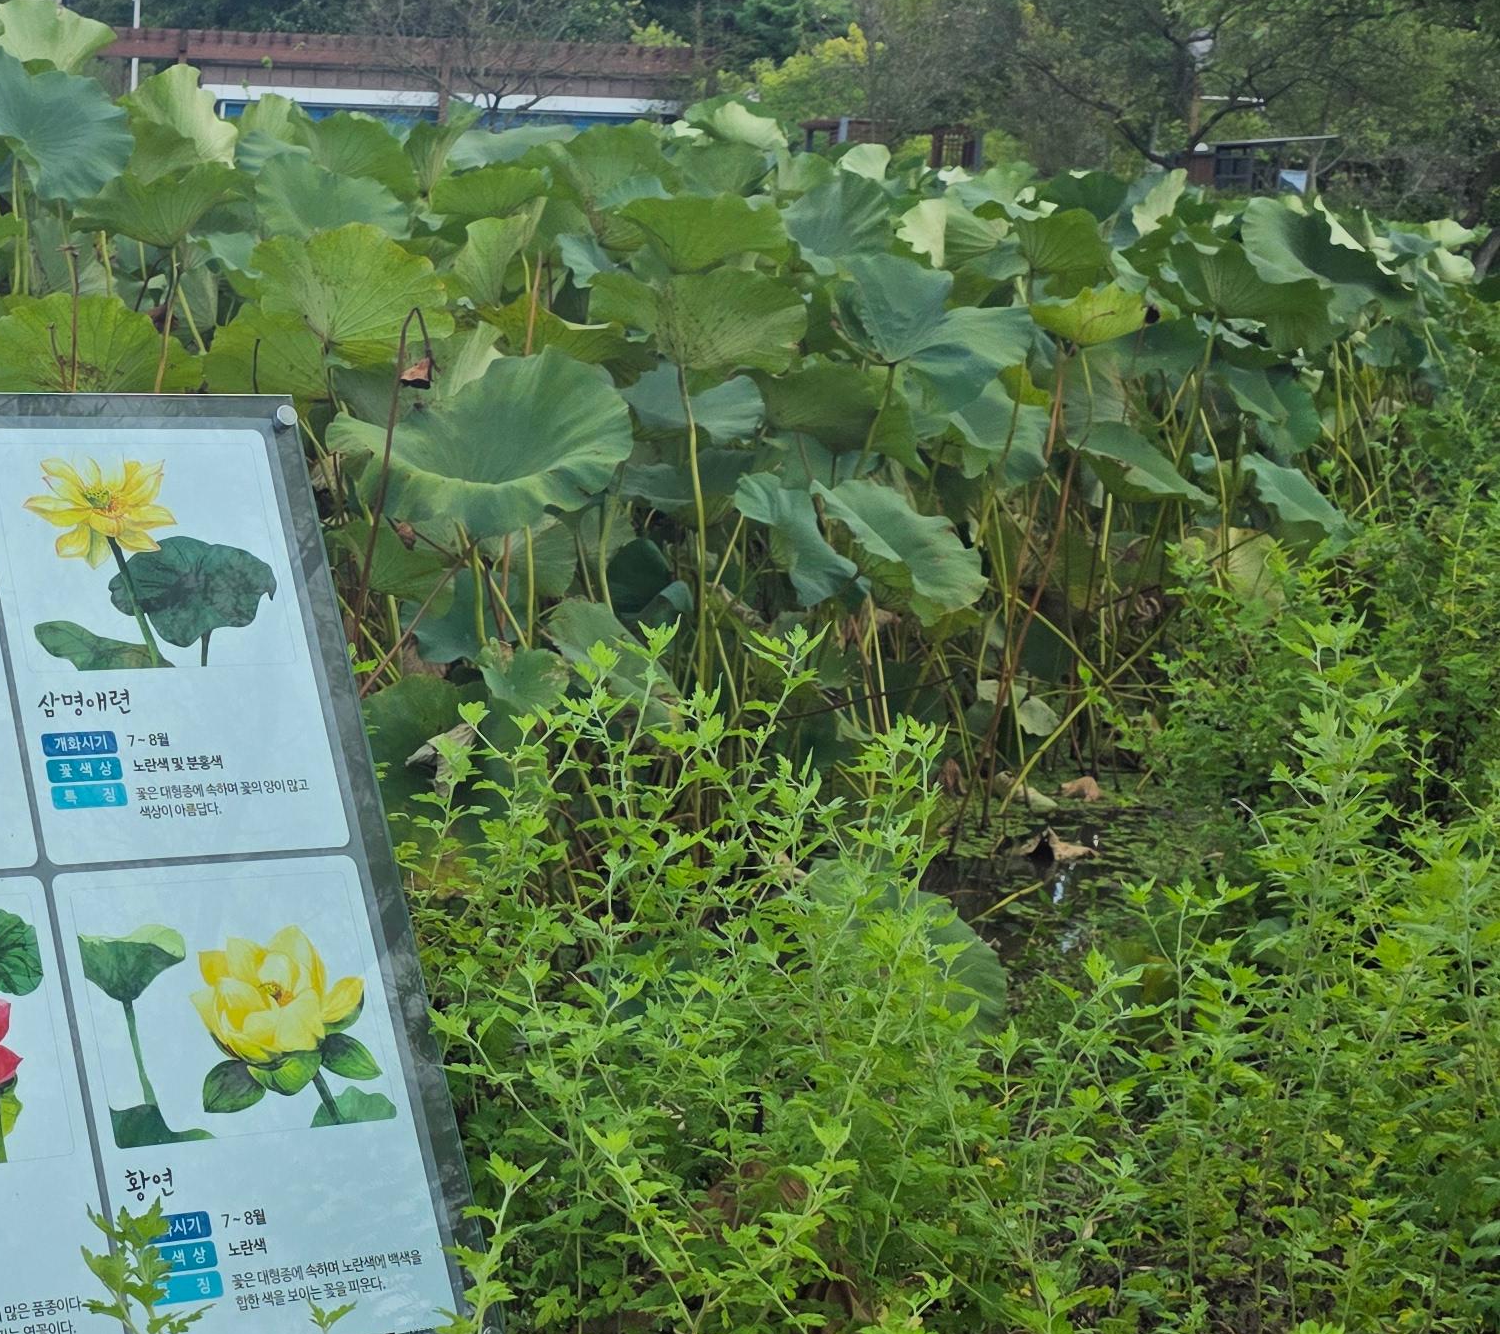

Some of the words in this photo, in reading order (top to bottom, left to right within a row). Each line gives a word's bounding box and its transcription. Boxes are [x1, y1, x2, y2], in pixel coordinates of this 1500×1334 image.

[37, 688, 131, 718] 삼명애련
[54, 736, 108, 752] 개화시기
[133, 757, 170, 773] 노란색
[171, 756, 185, 772] 및
[186, 754, 224, 770] 분홍색
[136, 786, 159, 800] 꽃은
[160, 783, 204, 800] 대형종에
[206, 782, 238, 797] 속하며
[240, 780, 263, 795] 꽃의
[287, 778, 310, 793] 많고
[139, 804, 174, 820] 색상이
[175, 802, 223, 818] 아름답다.
[125, 1167, 175, 1202] 황연
[228, 1237, 268, 1257] 노란색
[232, 1271, 256, 1290] 꽃은
[257, 1265, 304, 1286] 대형종에
[305, 1260, 340, 1277] 속하며
[342, 1254, 386, 1273] 노란색에
[388, 1249, 422, 1266] 백색을
[261, 1288, 286, 1307] 색을
[287, 1284, 322, 1303] 보이는
[323, 1280, 347, 1299] 꽃을
[349, 1275, 386, 1295] 피운다.
[4, 1302, 31, 1322] 많은
